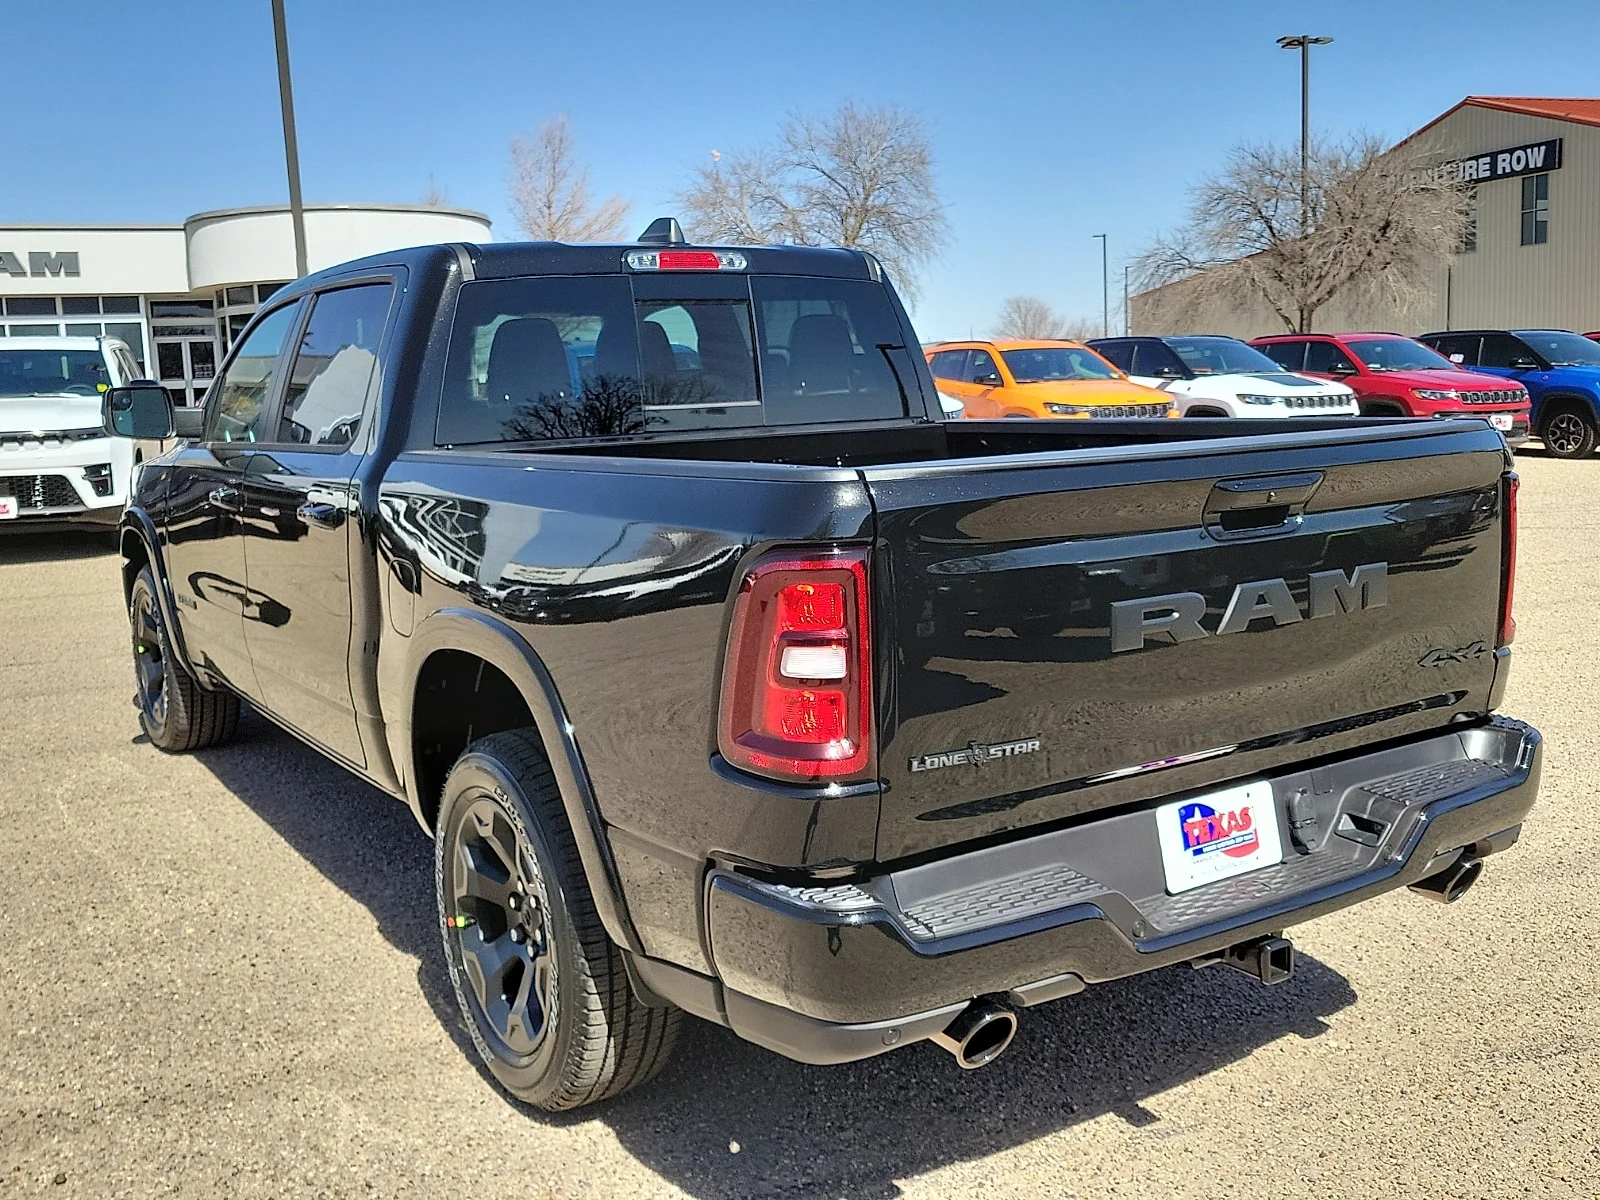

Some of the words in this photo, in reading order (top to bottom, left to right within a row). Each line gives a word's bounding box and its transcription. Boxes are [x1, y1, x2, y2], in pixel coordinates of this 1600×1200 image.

[1497, 146, 1547, 175] ROW
[0, 251, 80, 278] AM
[1111, 562, 1389, 653] RAM
[908, 749, 971, 772] LONE
[988, 739, 1041, 760] STAR
[1183, 806, 1253, 848] TEXAS
